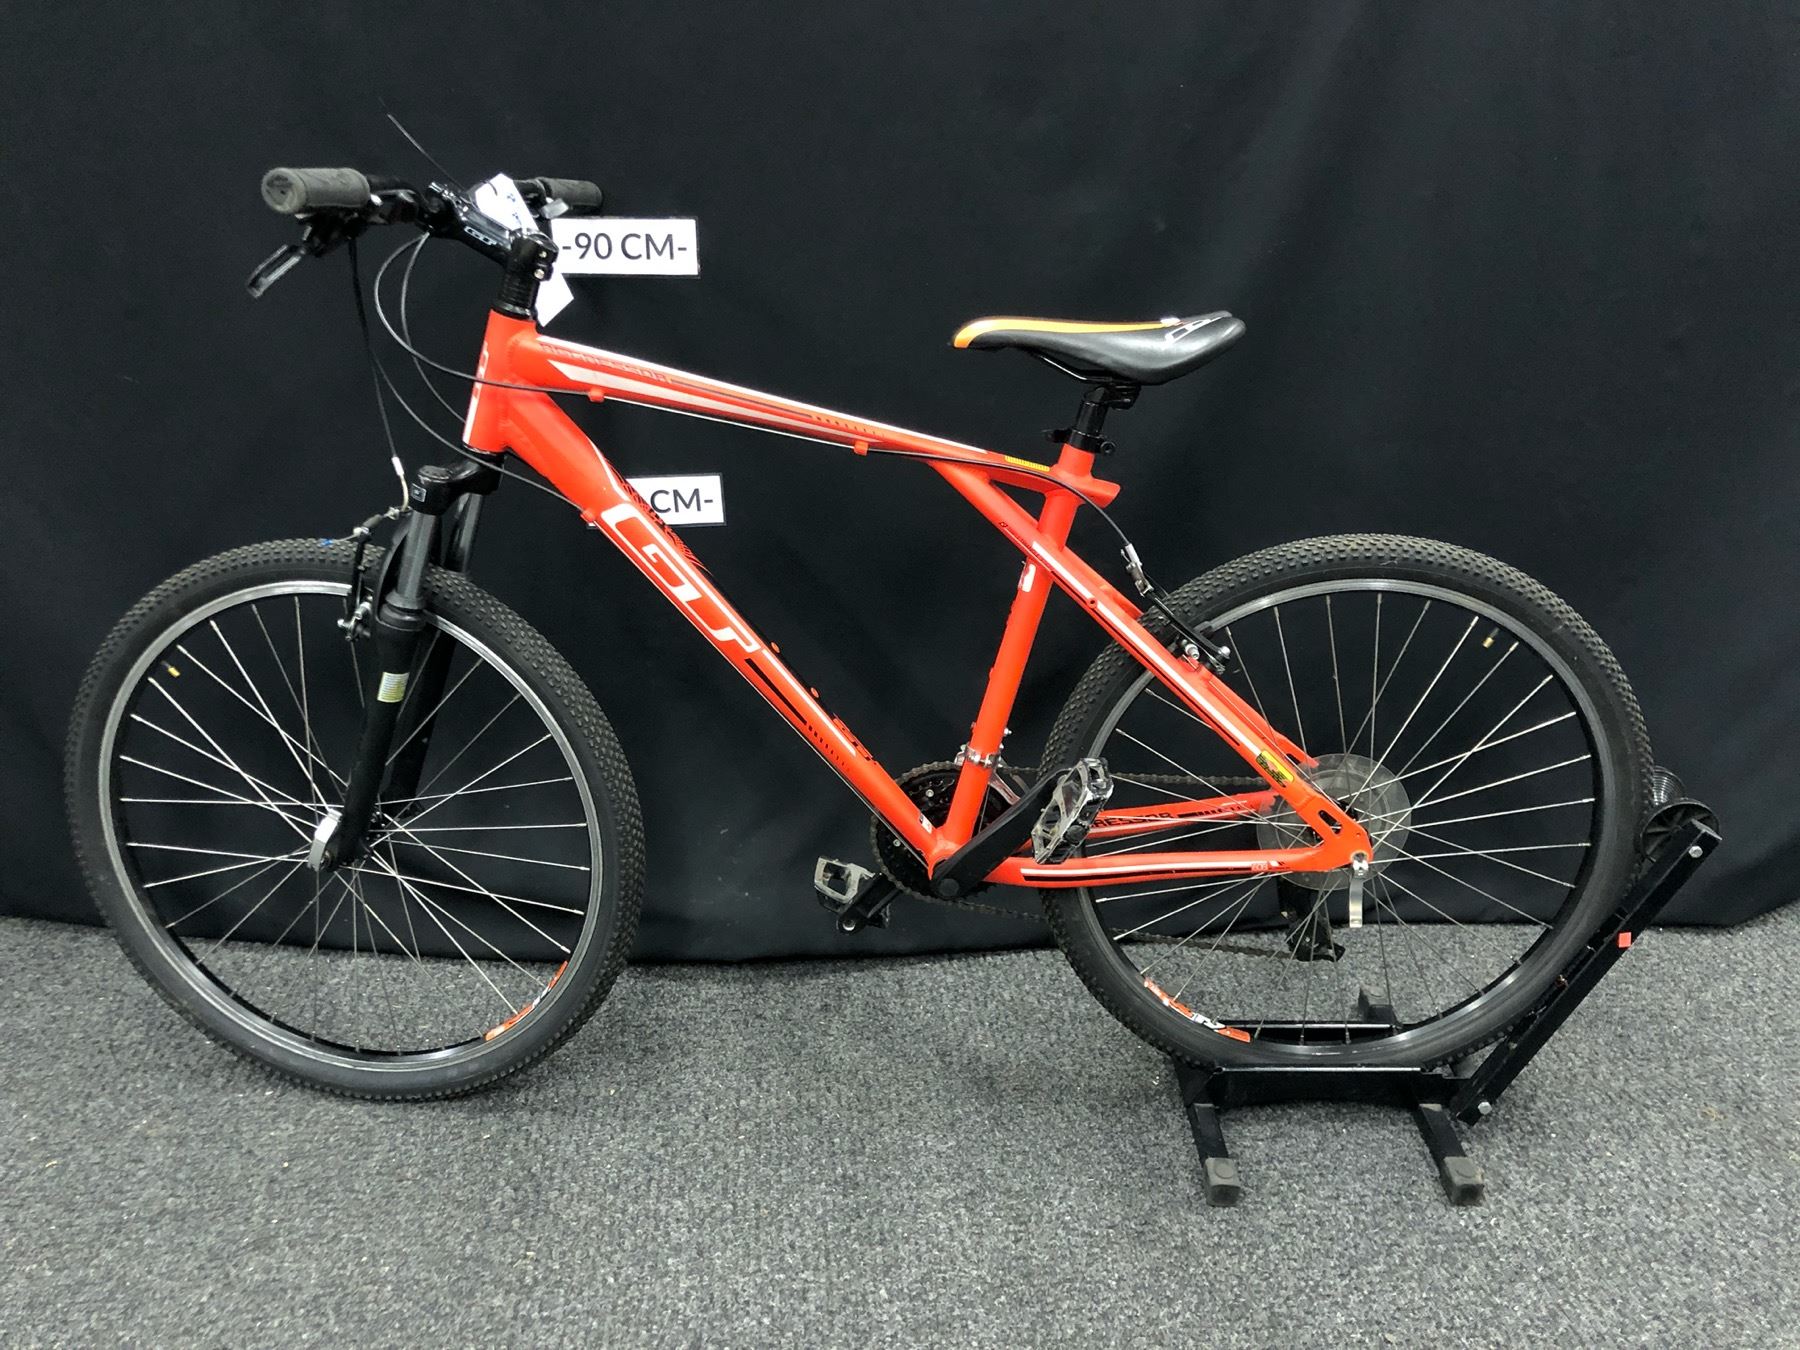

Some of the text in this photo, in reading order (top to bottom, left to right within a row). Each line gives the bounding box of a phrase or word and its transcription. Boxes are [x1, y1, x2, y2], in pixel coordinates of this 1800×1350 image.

[562, 232, 688, 261] -90 CM-
[650, 488, 714, 514] CM-
[601, 503, 762, 653] GT
